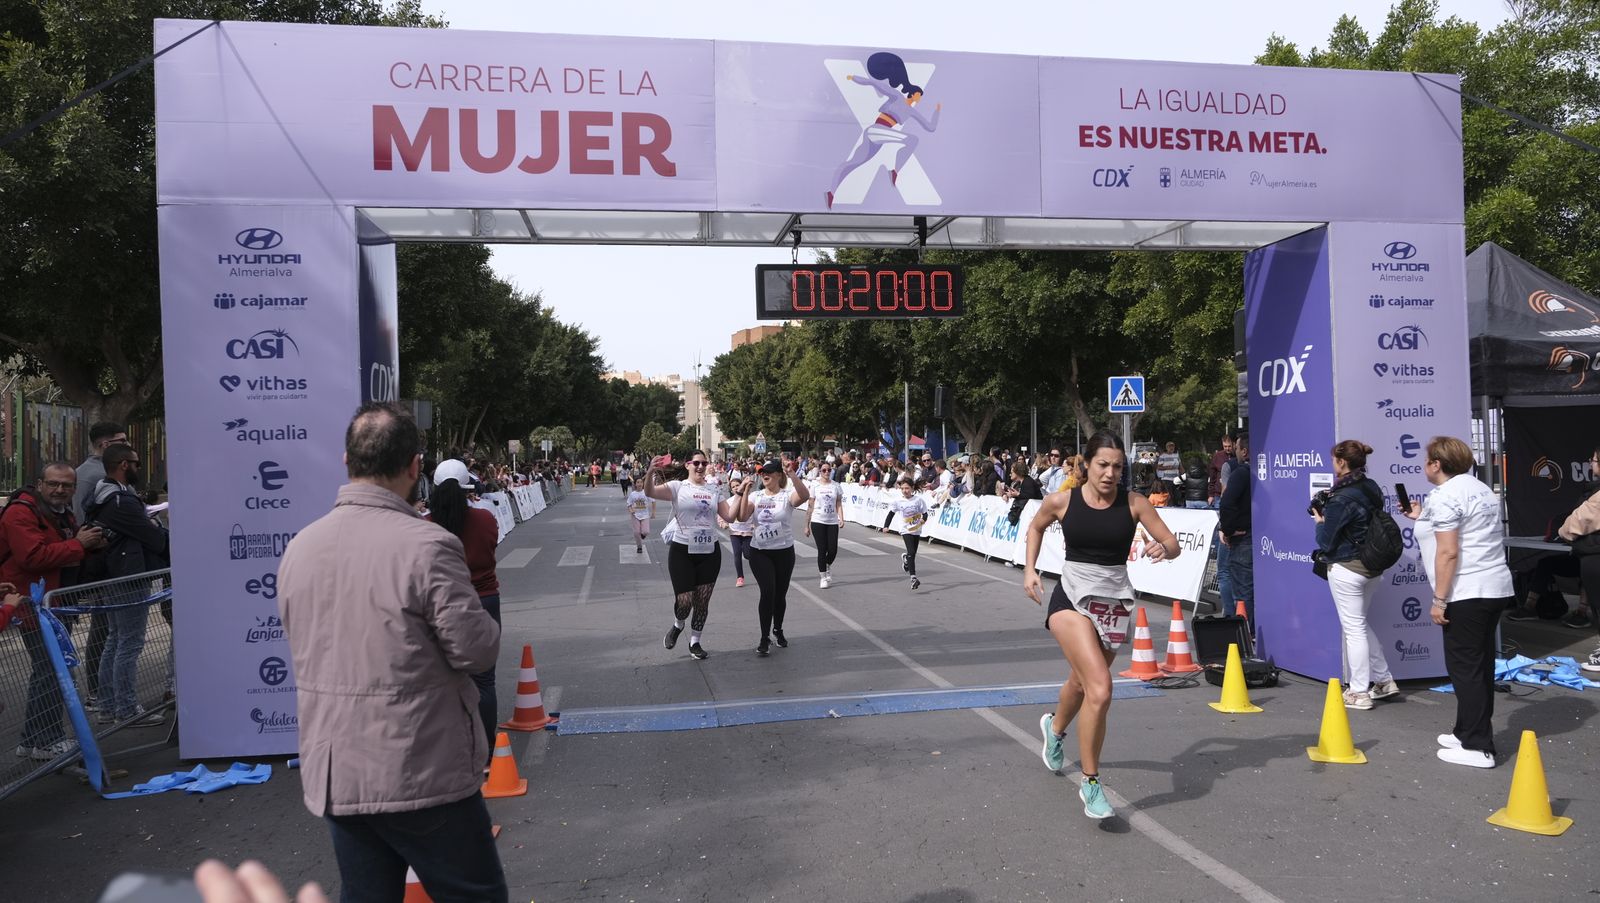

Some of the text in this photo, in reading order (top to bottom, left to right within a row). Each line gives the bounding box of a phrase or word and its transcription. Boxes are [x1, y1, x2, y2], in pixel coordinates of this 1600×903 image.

[389, 62, 658, 96] CARRERA DE LA
[1120, 87, 1287, 116] LA IGUALDAD
[372, 104, 677, 177] MUJER
[1078, 125, 1328, 154] ES NUESTRA META.
[1093, 165, 1134, 187] CDX
[1180, 167, 1227, 180] ALMERÍA
[218, 254, 302, 265] HYUNDAI
[1372, 262, 1430, 272] HYUNDAI
[229, 267, 293, 277] Almerialva
[1379, 273, 1424, 282] Almerialva
[792, 270, 953, 311] 00:20:00
[240, 294, 308, 310] cajamar
[1388, 295, 1435, 309] cajamar
[1377, 332, 1418, 350] CASI
[226, 338, 284, 360] CASI
[1258, 350, 1309, 397] CDX
[1392, 364, 1435, 377] vithas
[246, 375, 308, 391] vithas
[262, 393, 278, 401] para
[1385, 404, 1435, 421] aqualia
[236, 424, 308, 445] aqualia
[1273, 450, 1324, 467] ALMERÍA
[1273, 469, 1298, 479] CIUDAD
[1389, 463, 1422, 475] Clece
[245, 496, 291, 510] Clece
[760, 530, 779, 539] 1111
[248, 546, 273, 559] PIEDRA
[1097, 614, 1119, 628] 541
